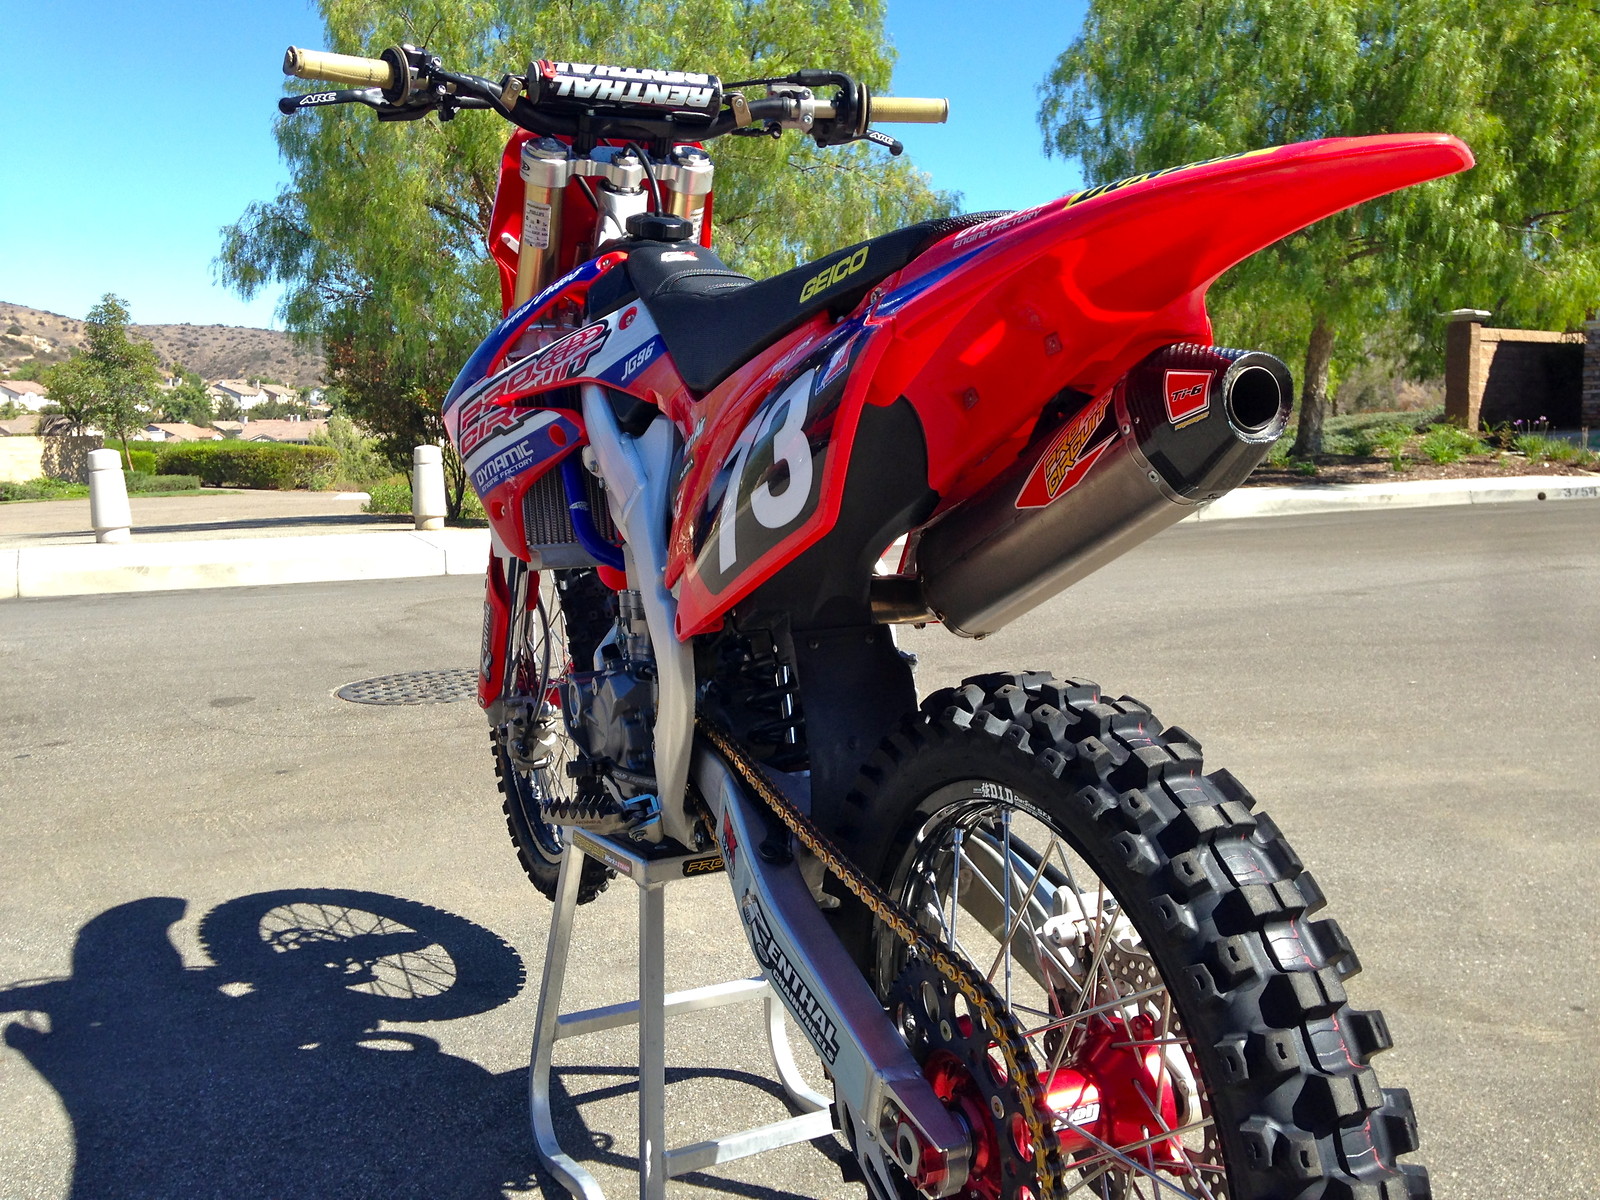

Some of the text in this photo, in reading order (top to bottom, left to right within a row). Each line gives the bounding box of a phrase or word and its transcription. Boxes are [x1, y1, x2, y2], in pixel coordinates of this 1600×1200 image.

[300, 92, 337, 105] ARC
[553, 76, 714, 107] RENTHAL
[990, 208, 1043, 234] FACTORY
[799, 246, 869, 303] GEICO
[621, 341, 655, 381] JG96
[461, 361, 536, 431] PRO
[1171, 384, 1204, 403] Ti-6
[475, 439, 534, 486] DYNAMIC
[1046, 420, 1080, 477] PRO
[1047, 394, 1110, 497] CIRCUIT
[500, 456, 533, 478] FACTORY
[687, 857, 724, 873] PRO
